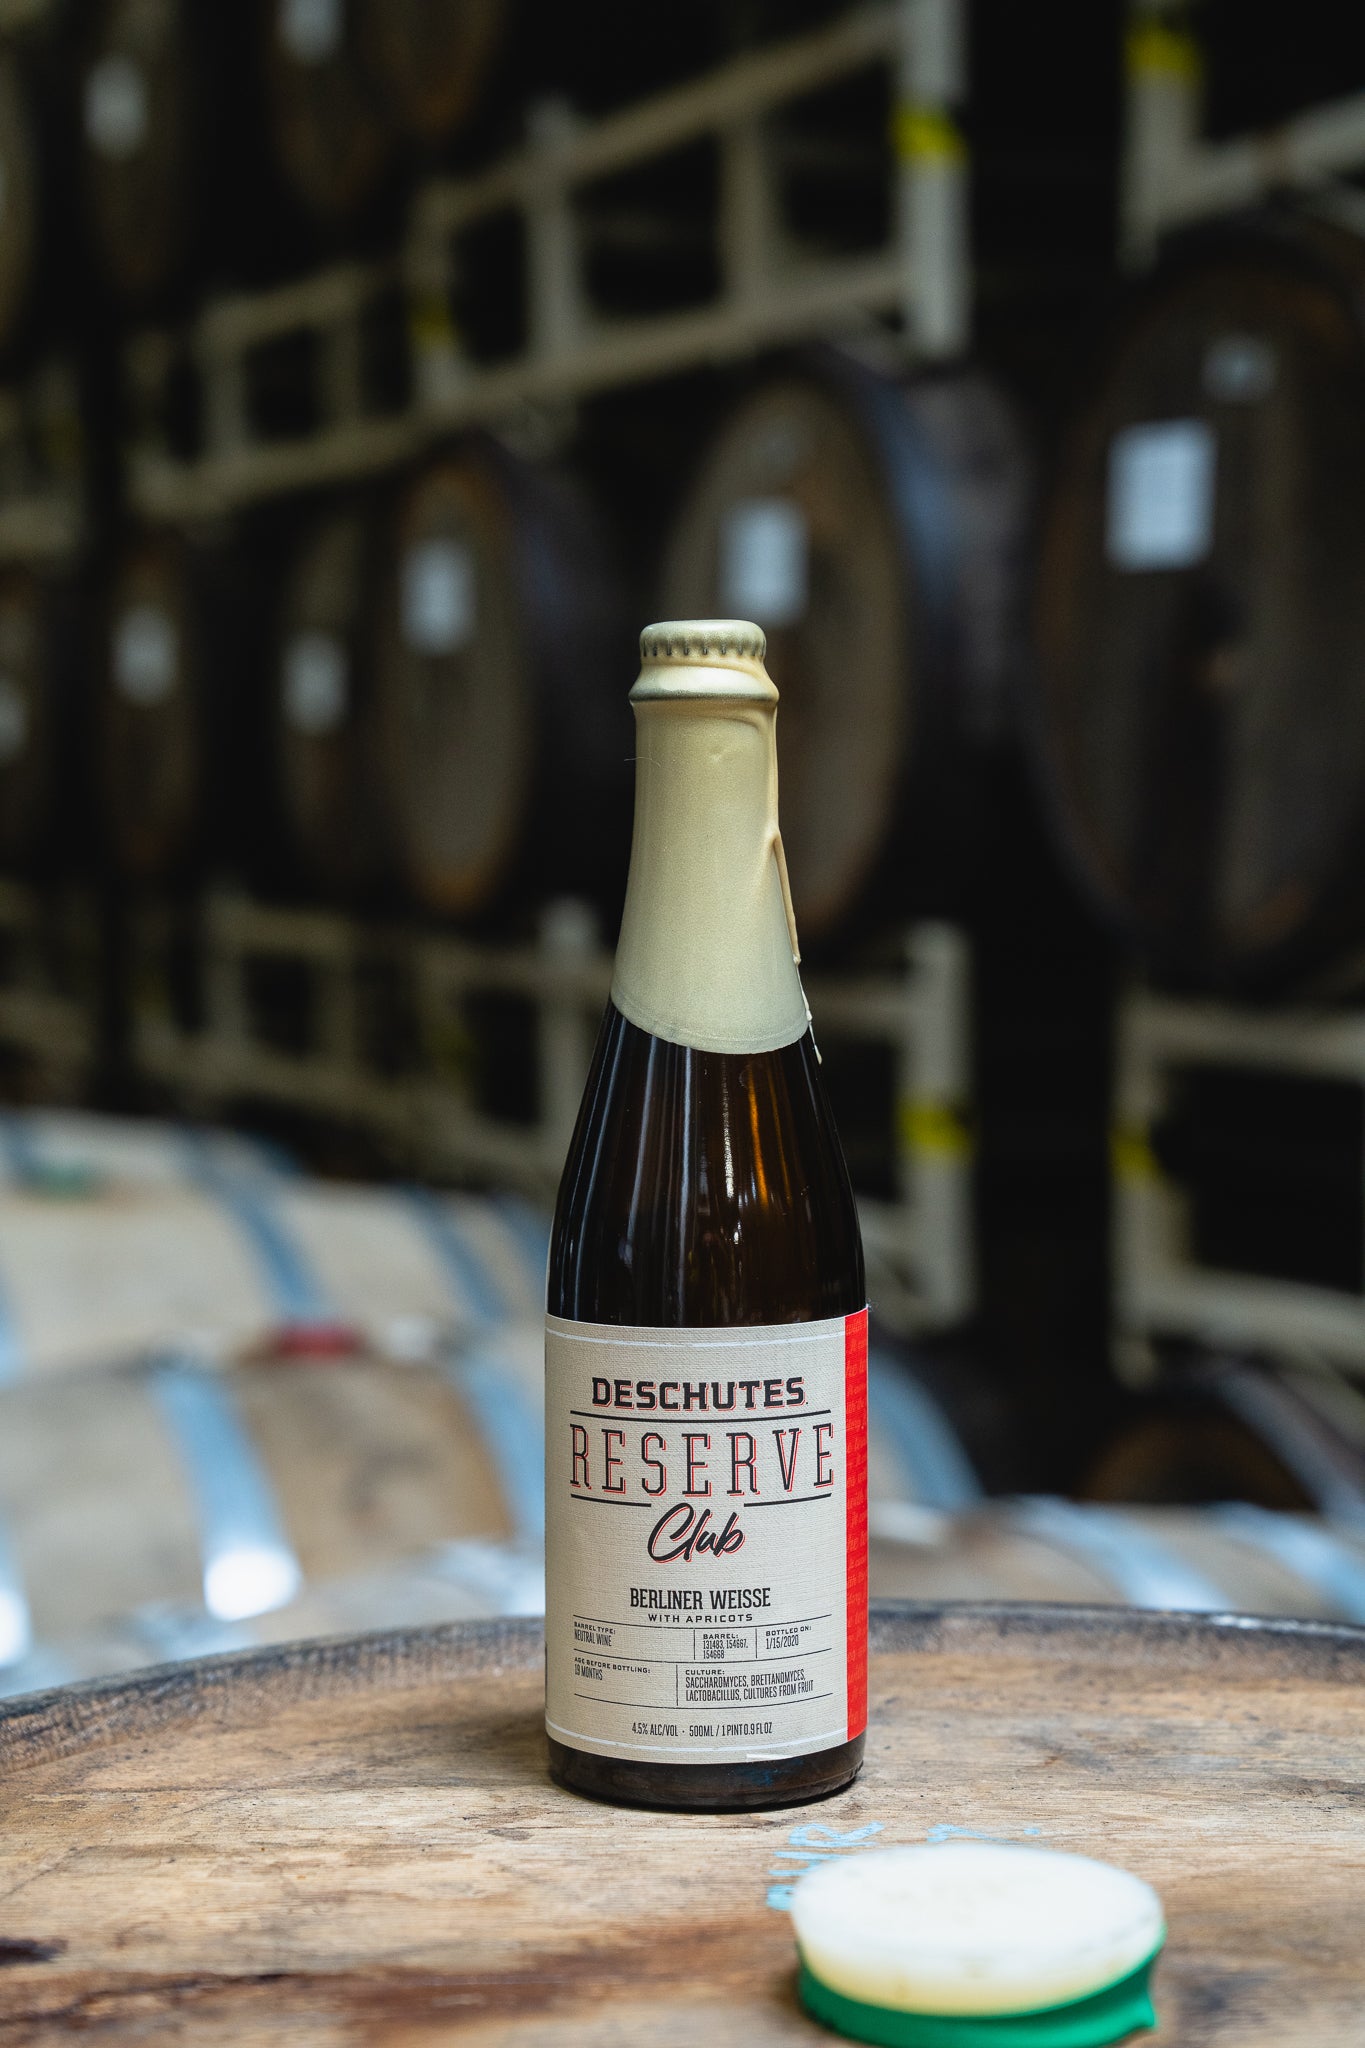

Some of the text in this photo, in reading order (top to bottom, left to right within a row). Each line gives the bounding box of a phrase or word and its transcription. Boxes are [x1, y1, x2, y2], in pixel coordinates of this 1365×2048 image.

[592, 1377, 806, 1411] DESCHUTES
[570, 1423, 834, 1497] RESERVE
[647, 1502, 746, 1564] Club
[630, 1587, 771, 1610] BERLINER WEISSE
[648, 1613, 753, 1623] WITH APRICOTS
[574, 1621, 616, 1634] BARREL TYPE:
[766, 1628, 798, 1636] BOTTLED
[574, 1629, 612, 1646] NEUTRAL WINE
[766, 1636, 799, 1649] 1/15/2020
[581, 1666, 603, 1680] MONTHS
[586, 1659, 611, 1669] BEFORE
[612, 1664, 651, 1674] BOTTLING:
[685, 1669, 805, 1689] SACCHAROMYCES, BRETTANOMYCES,
[685, 1679, 814, 1702] LACTOBACILLUS, CULTURES FROM FRUIT
[650, 1724, 678, 1736] ALC/VOL
[689, 1724, 714, 1737] 500ML
